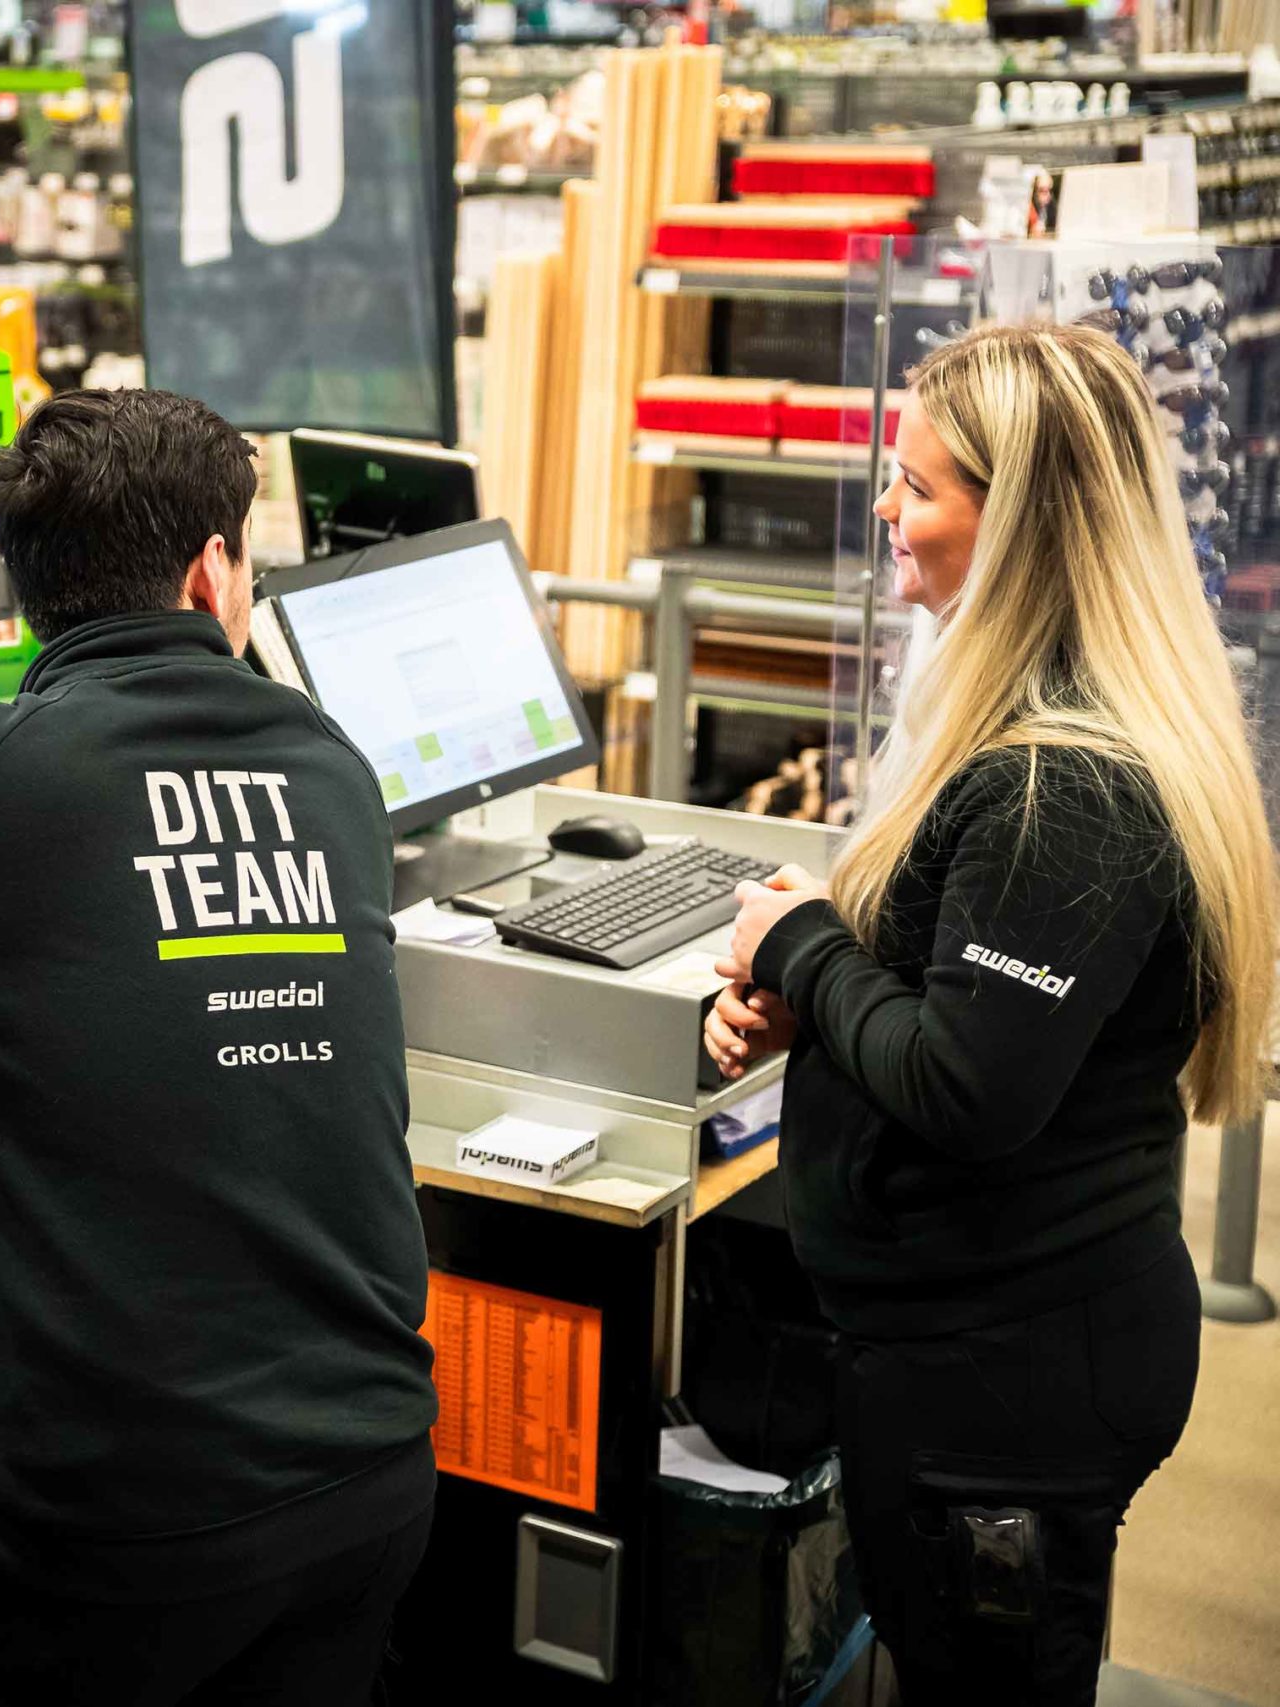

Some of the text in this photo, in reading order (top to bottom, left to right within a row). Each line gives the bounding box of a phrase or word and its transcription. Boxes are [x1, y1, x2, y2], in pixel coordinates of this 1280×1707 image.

[145, 770, 295, 845] DITT
[133, 851, 336, 931] TEAM
[207, 981, 324, 1011] swedol
[961, 943, 1076, 998] swedol
[217, 1041, 333, 1066] GROLLS
